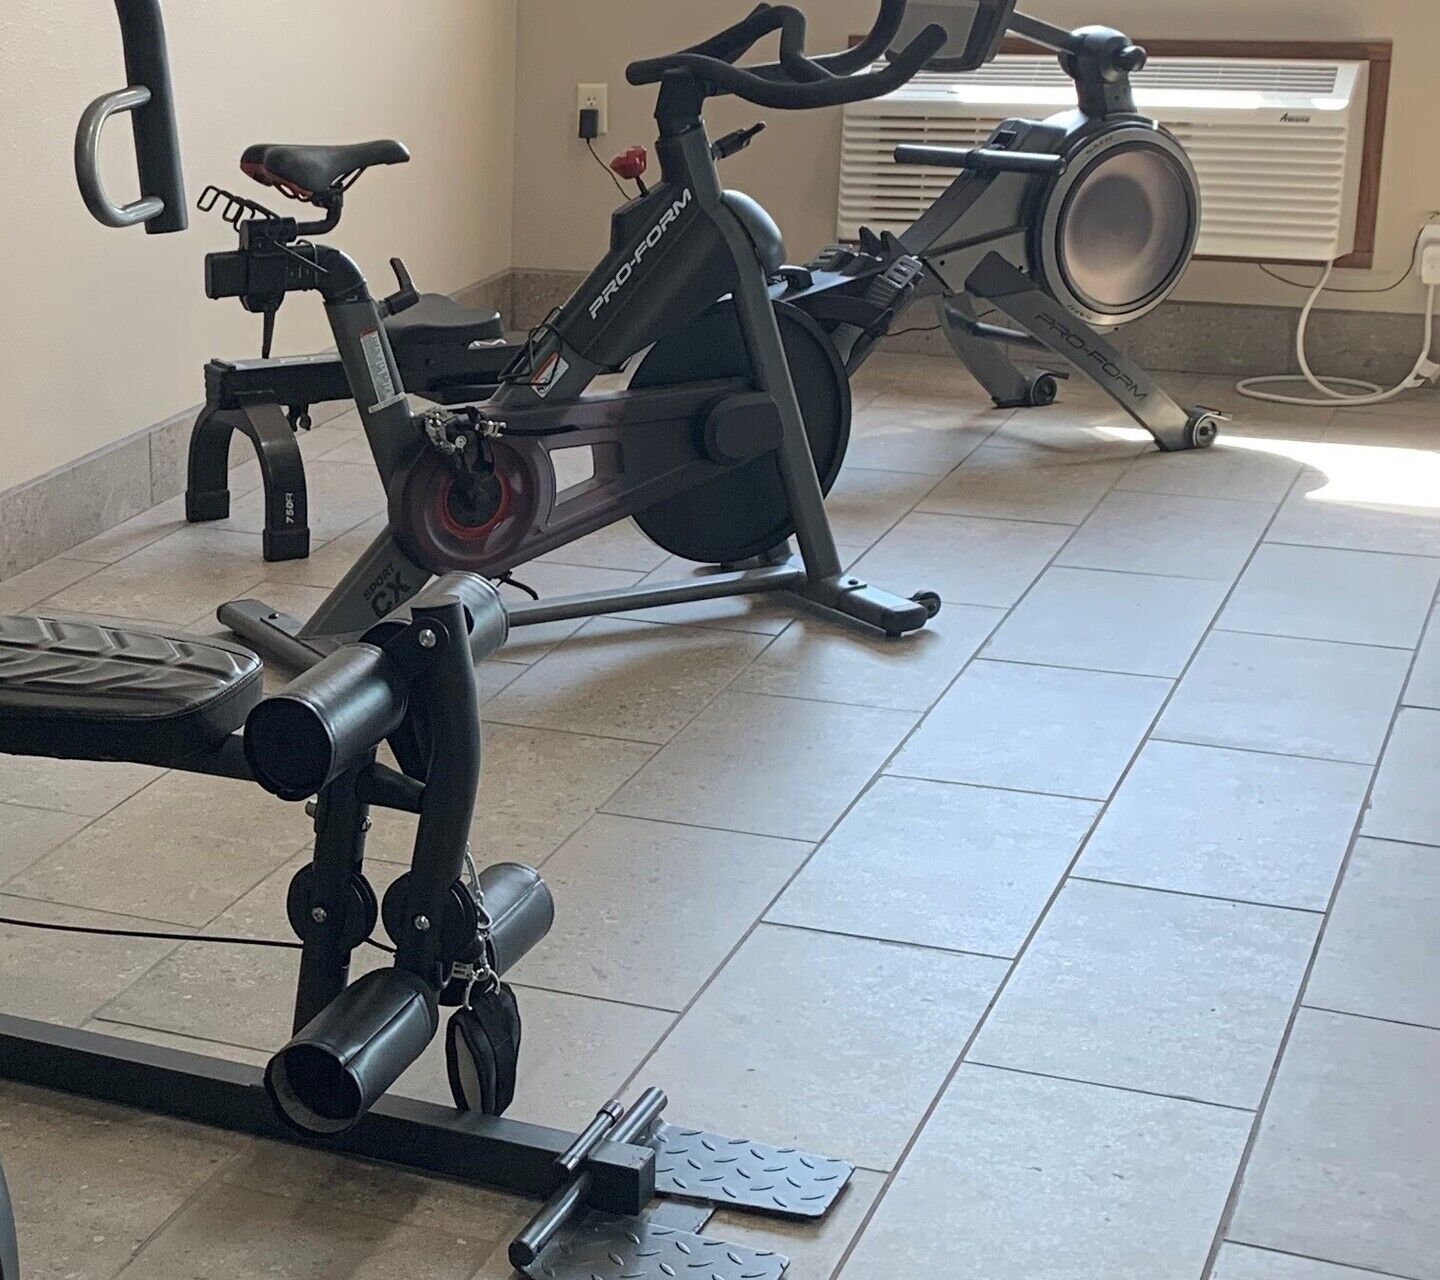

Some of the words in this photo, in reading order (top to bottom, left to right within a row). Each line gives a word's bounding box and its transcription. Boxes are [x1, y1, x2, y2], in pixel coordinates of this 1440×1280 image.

[588, 187, 692, 320] PRO-FORM
[1034, 312, 1148, 401] PRO-FORM
[285, 492, 295, 524] 750R
[371, 570, 411, 619] CX
